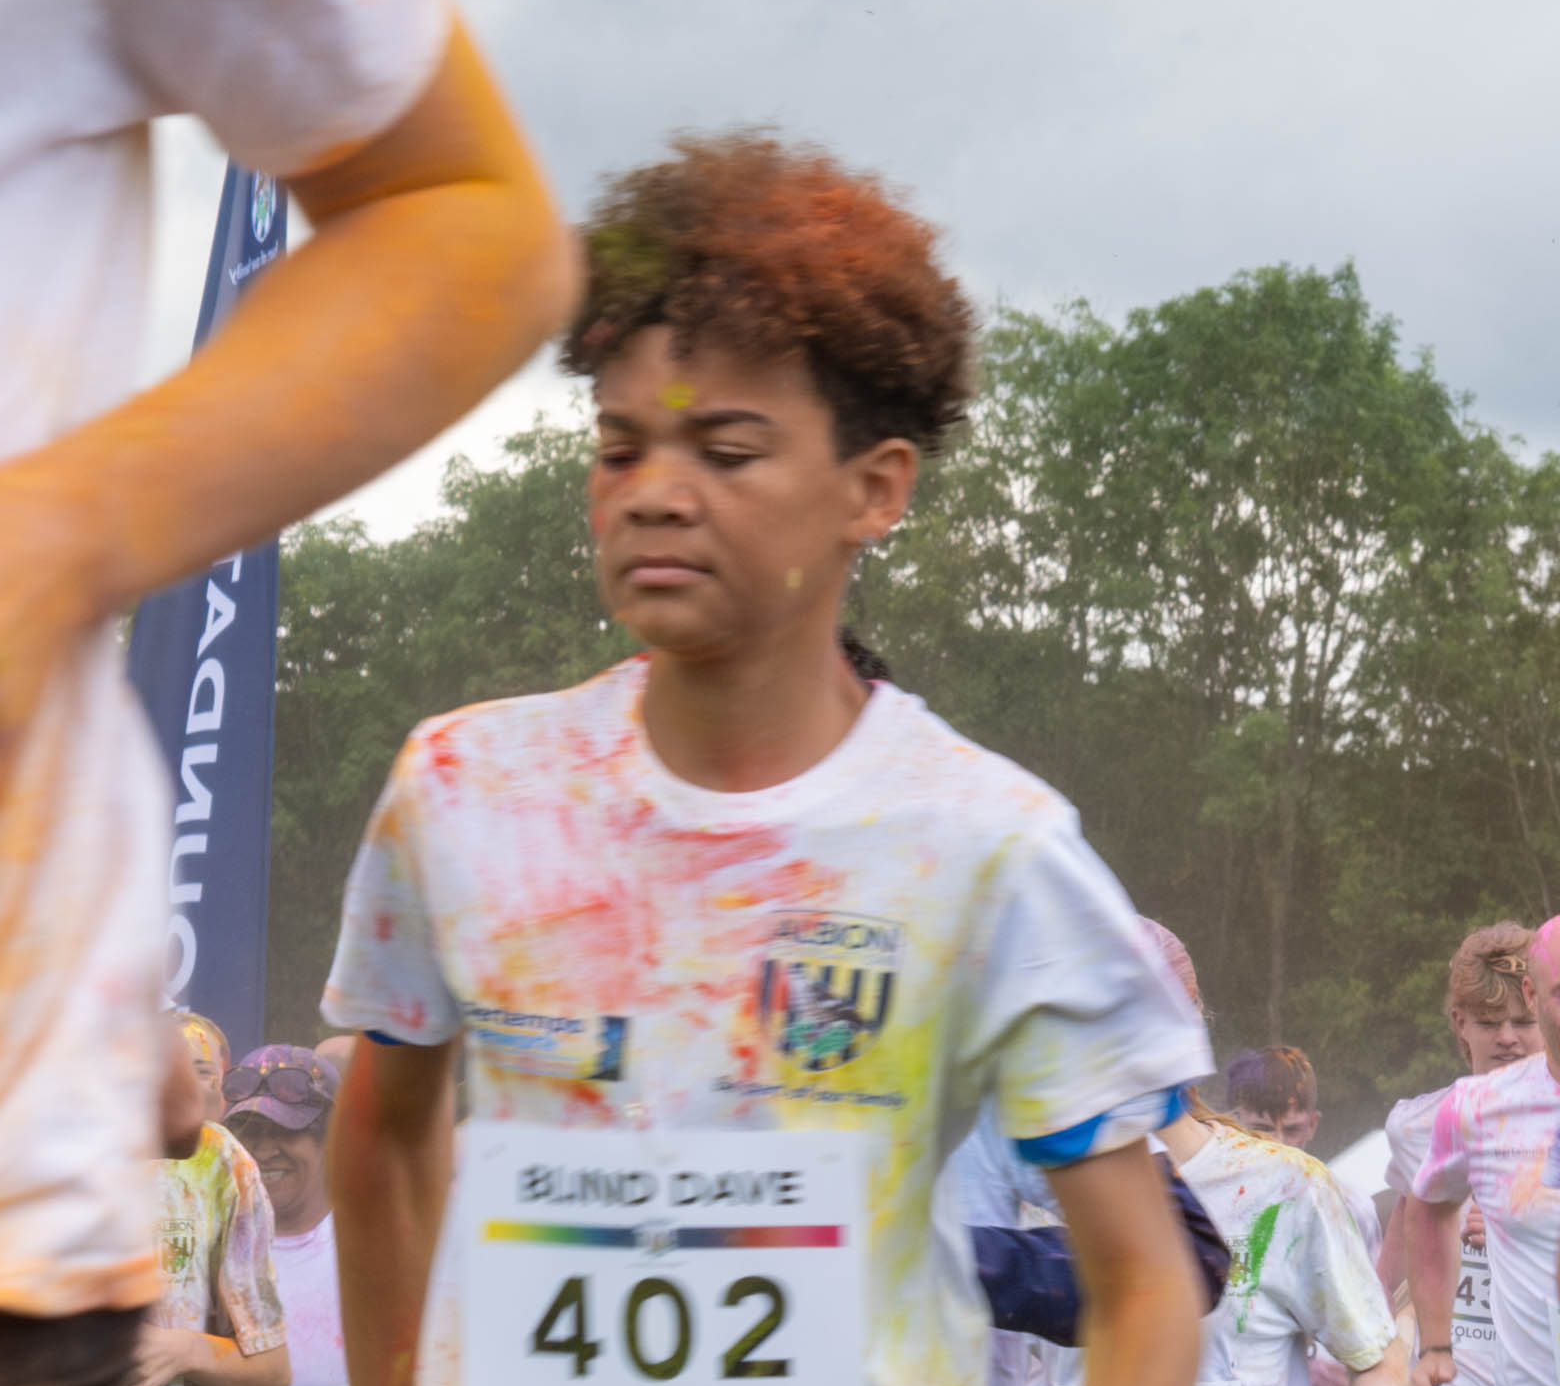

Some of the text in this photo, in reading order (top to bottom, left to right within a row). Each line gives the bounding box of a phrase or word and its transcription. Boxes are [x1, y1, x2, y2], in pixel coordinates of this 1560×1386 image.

[519, 1165, 804, 1208] BLIND DAVE
[530, 1274, 794, 1381] 402
[1451, 1324, 1497, 1341] OLOU
